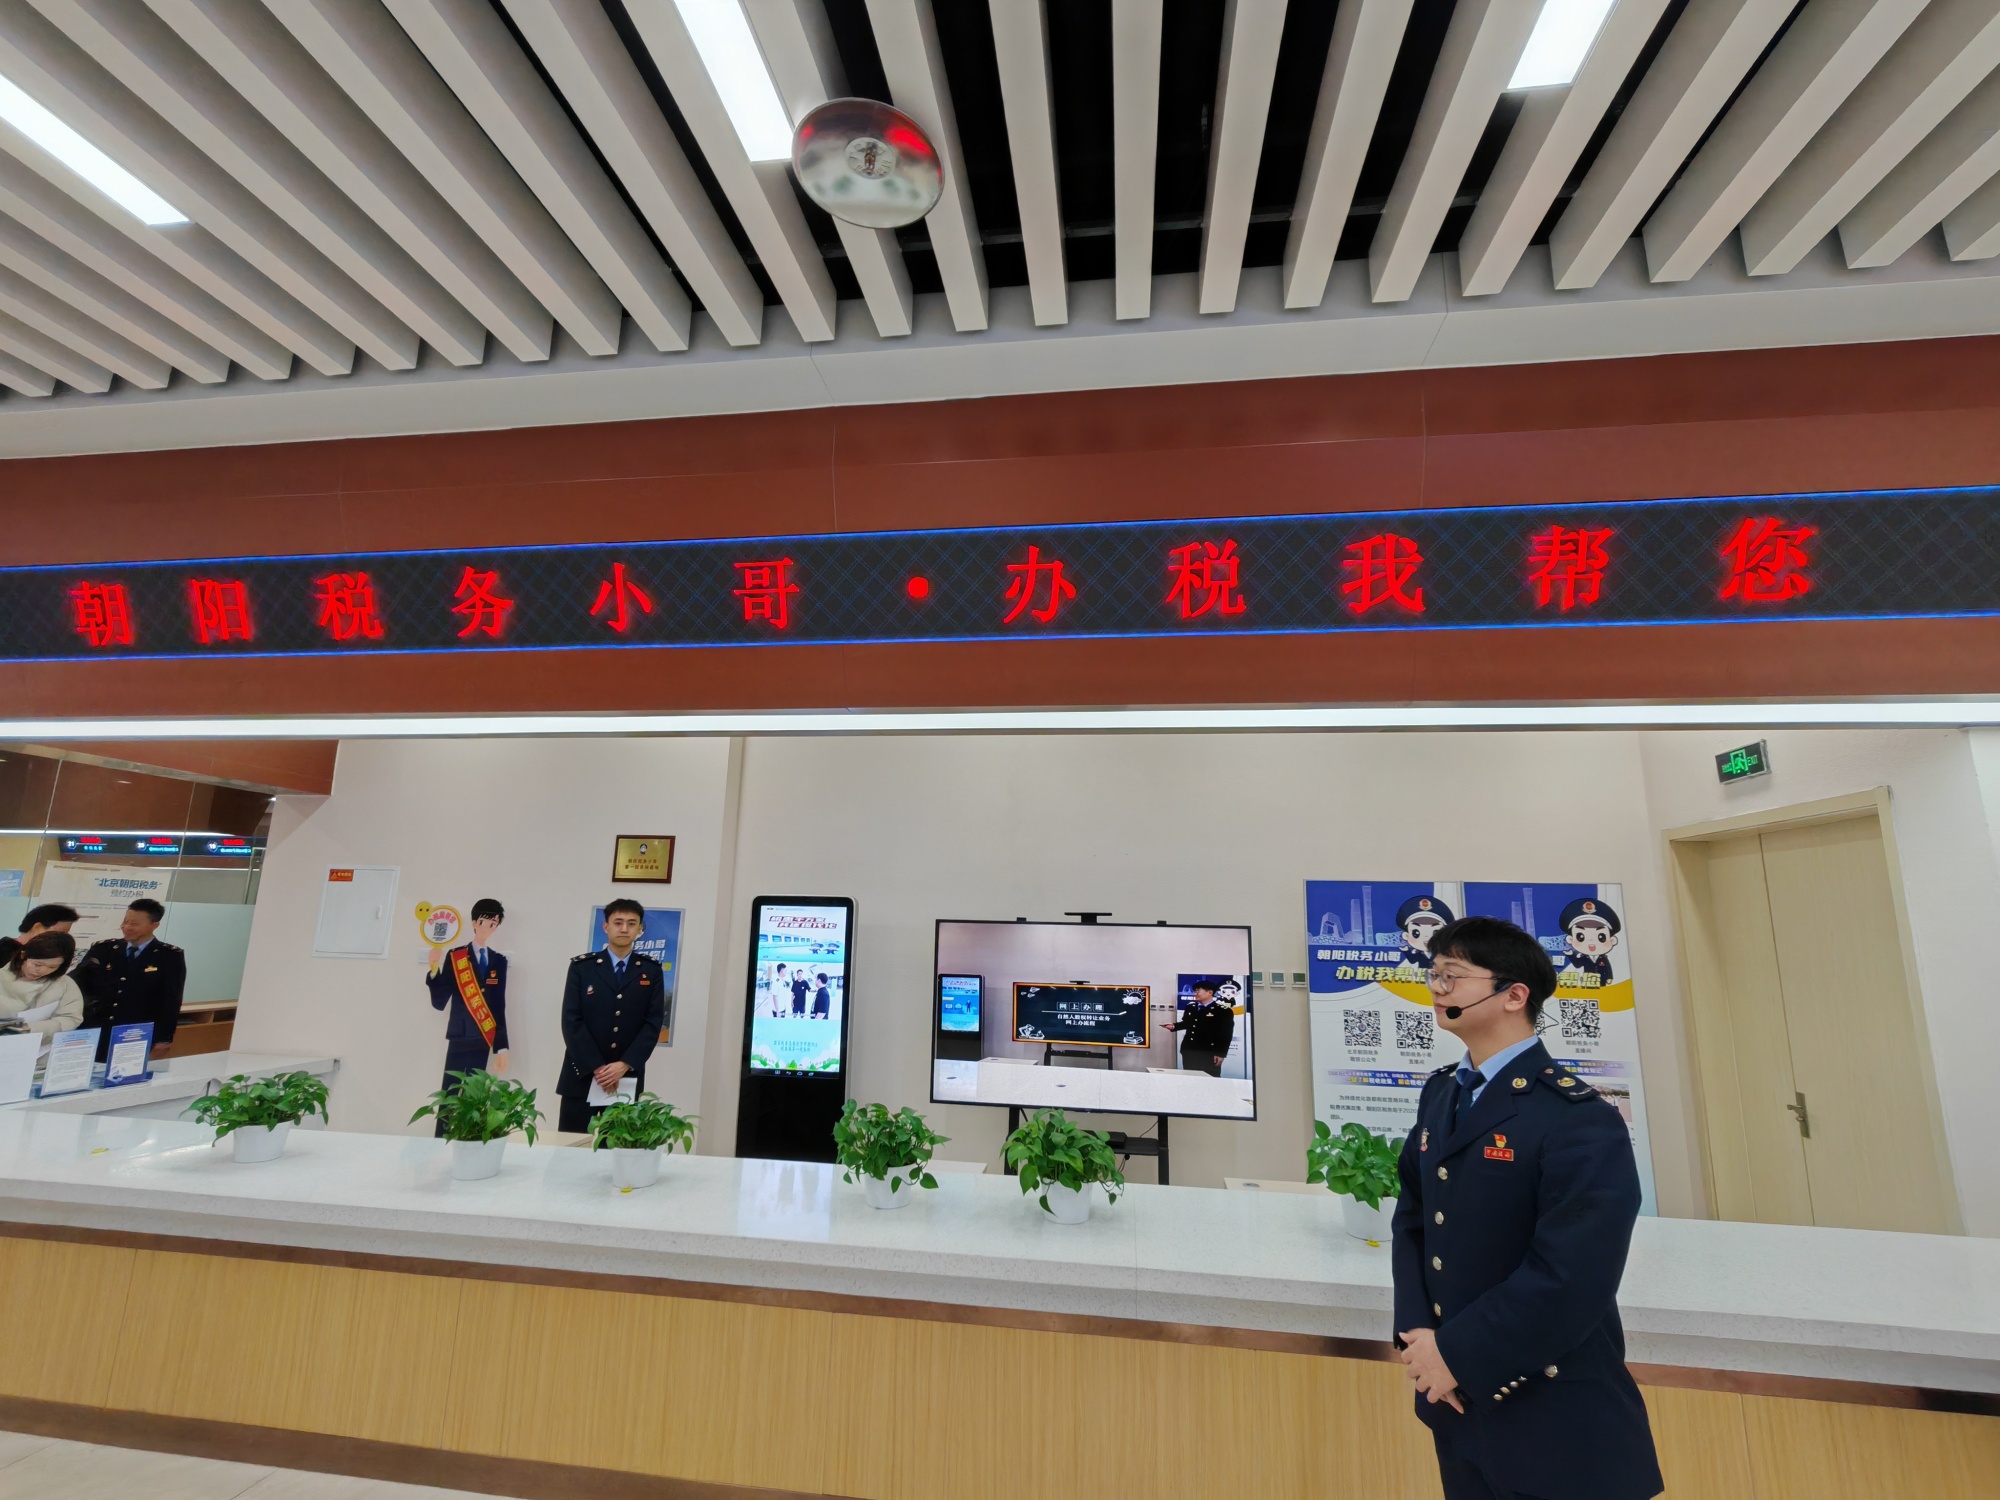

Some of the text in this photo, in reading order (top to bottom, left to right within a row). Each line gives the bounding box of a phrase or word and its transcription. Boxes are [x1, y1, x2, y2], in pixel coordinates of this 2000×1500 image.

[1317, 949, 1401, 961] 朝阳税务小哥
